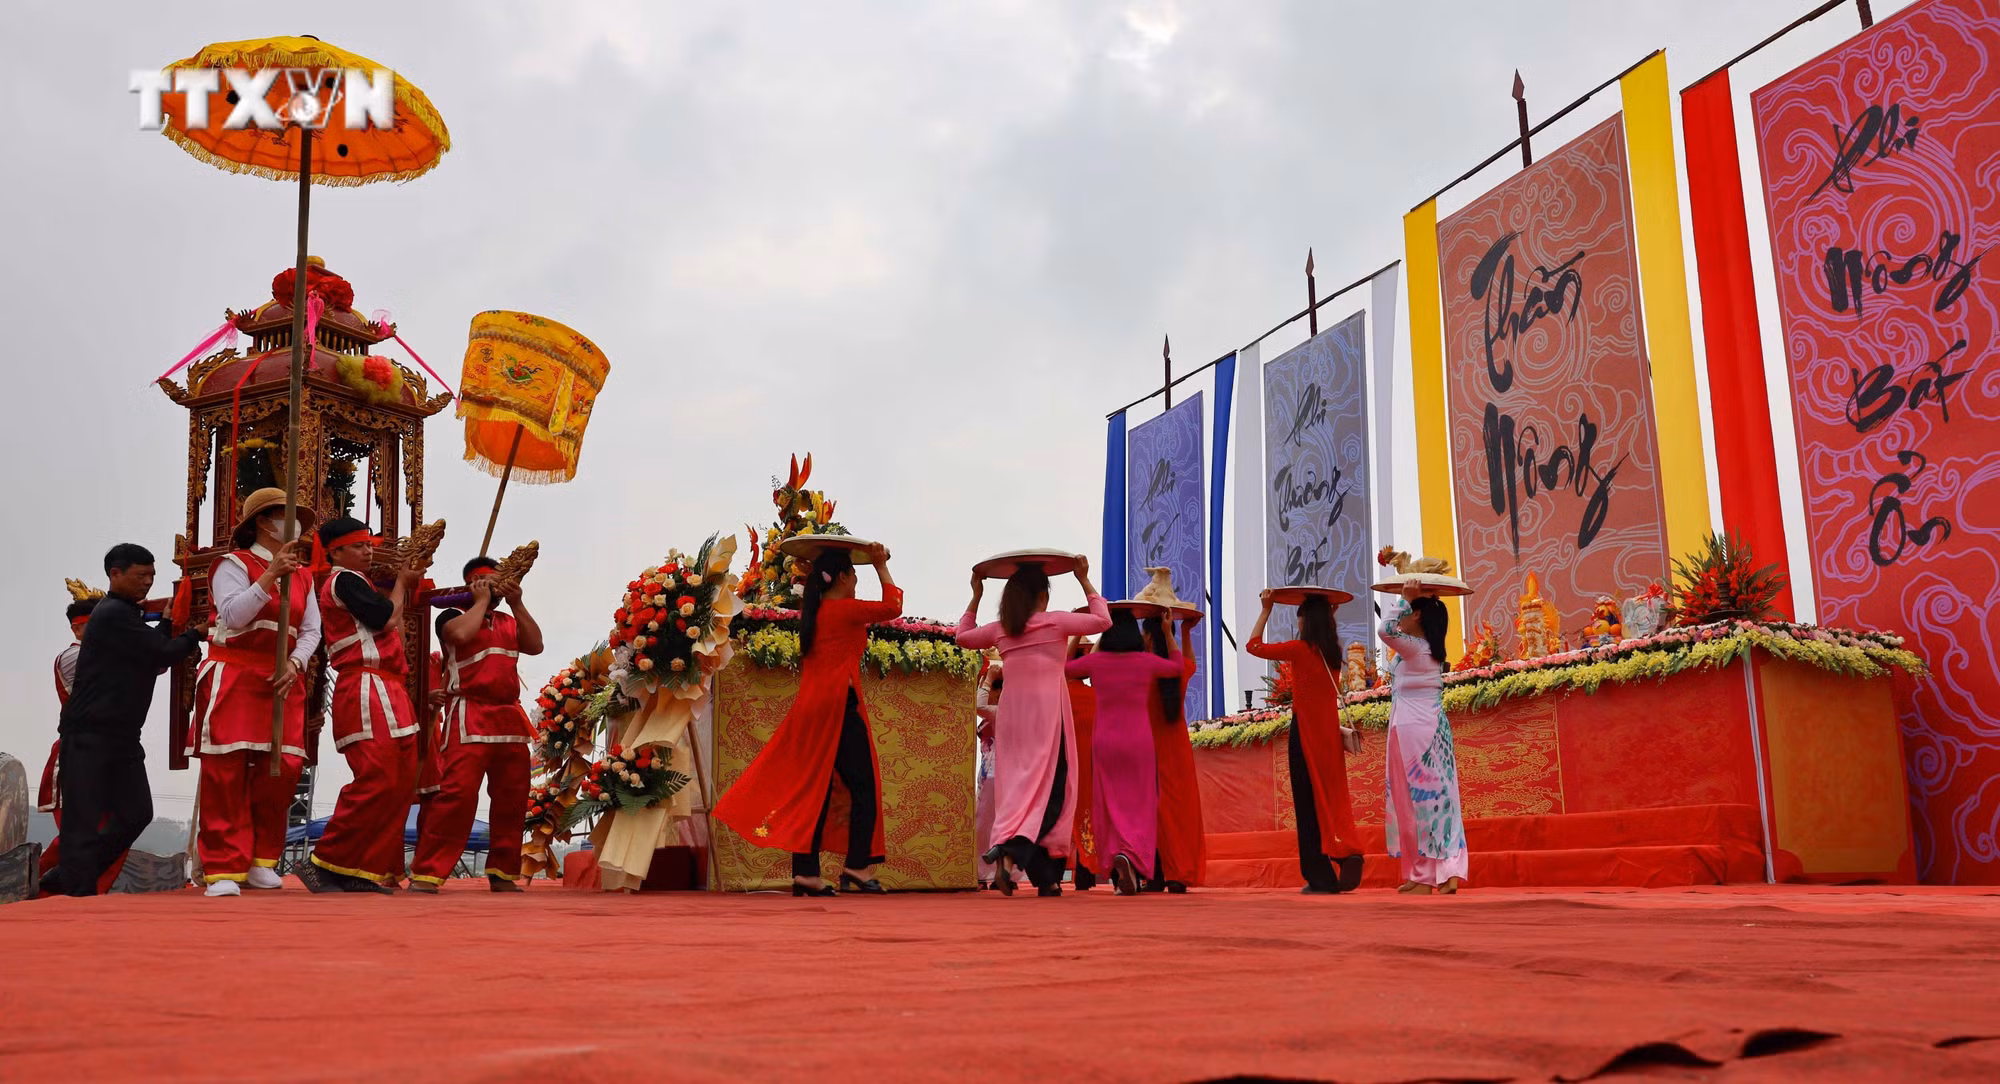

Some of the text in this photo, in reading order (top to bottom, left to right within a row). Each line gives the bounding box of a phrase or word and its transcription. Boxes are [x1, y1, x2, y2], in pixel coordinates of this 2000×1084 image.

[1805, 103, 1920, 206] Phi
[1823, 229, 1998, 320] Nông
[1284, 382, 1328, 448] Phi
[1846, 339, 1973, 433] Bất
[1139, 457, 1177, 513] Phi
[1482, 401, 1630, 574] Nông
[1869, 450, 1952, 567] Ổn
